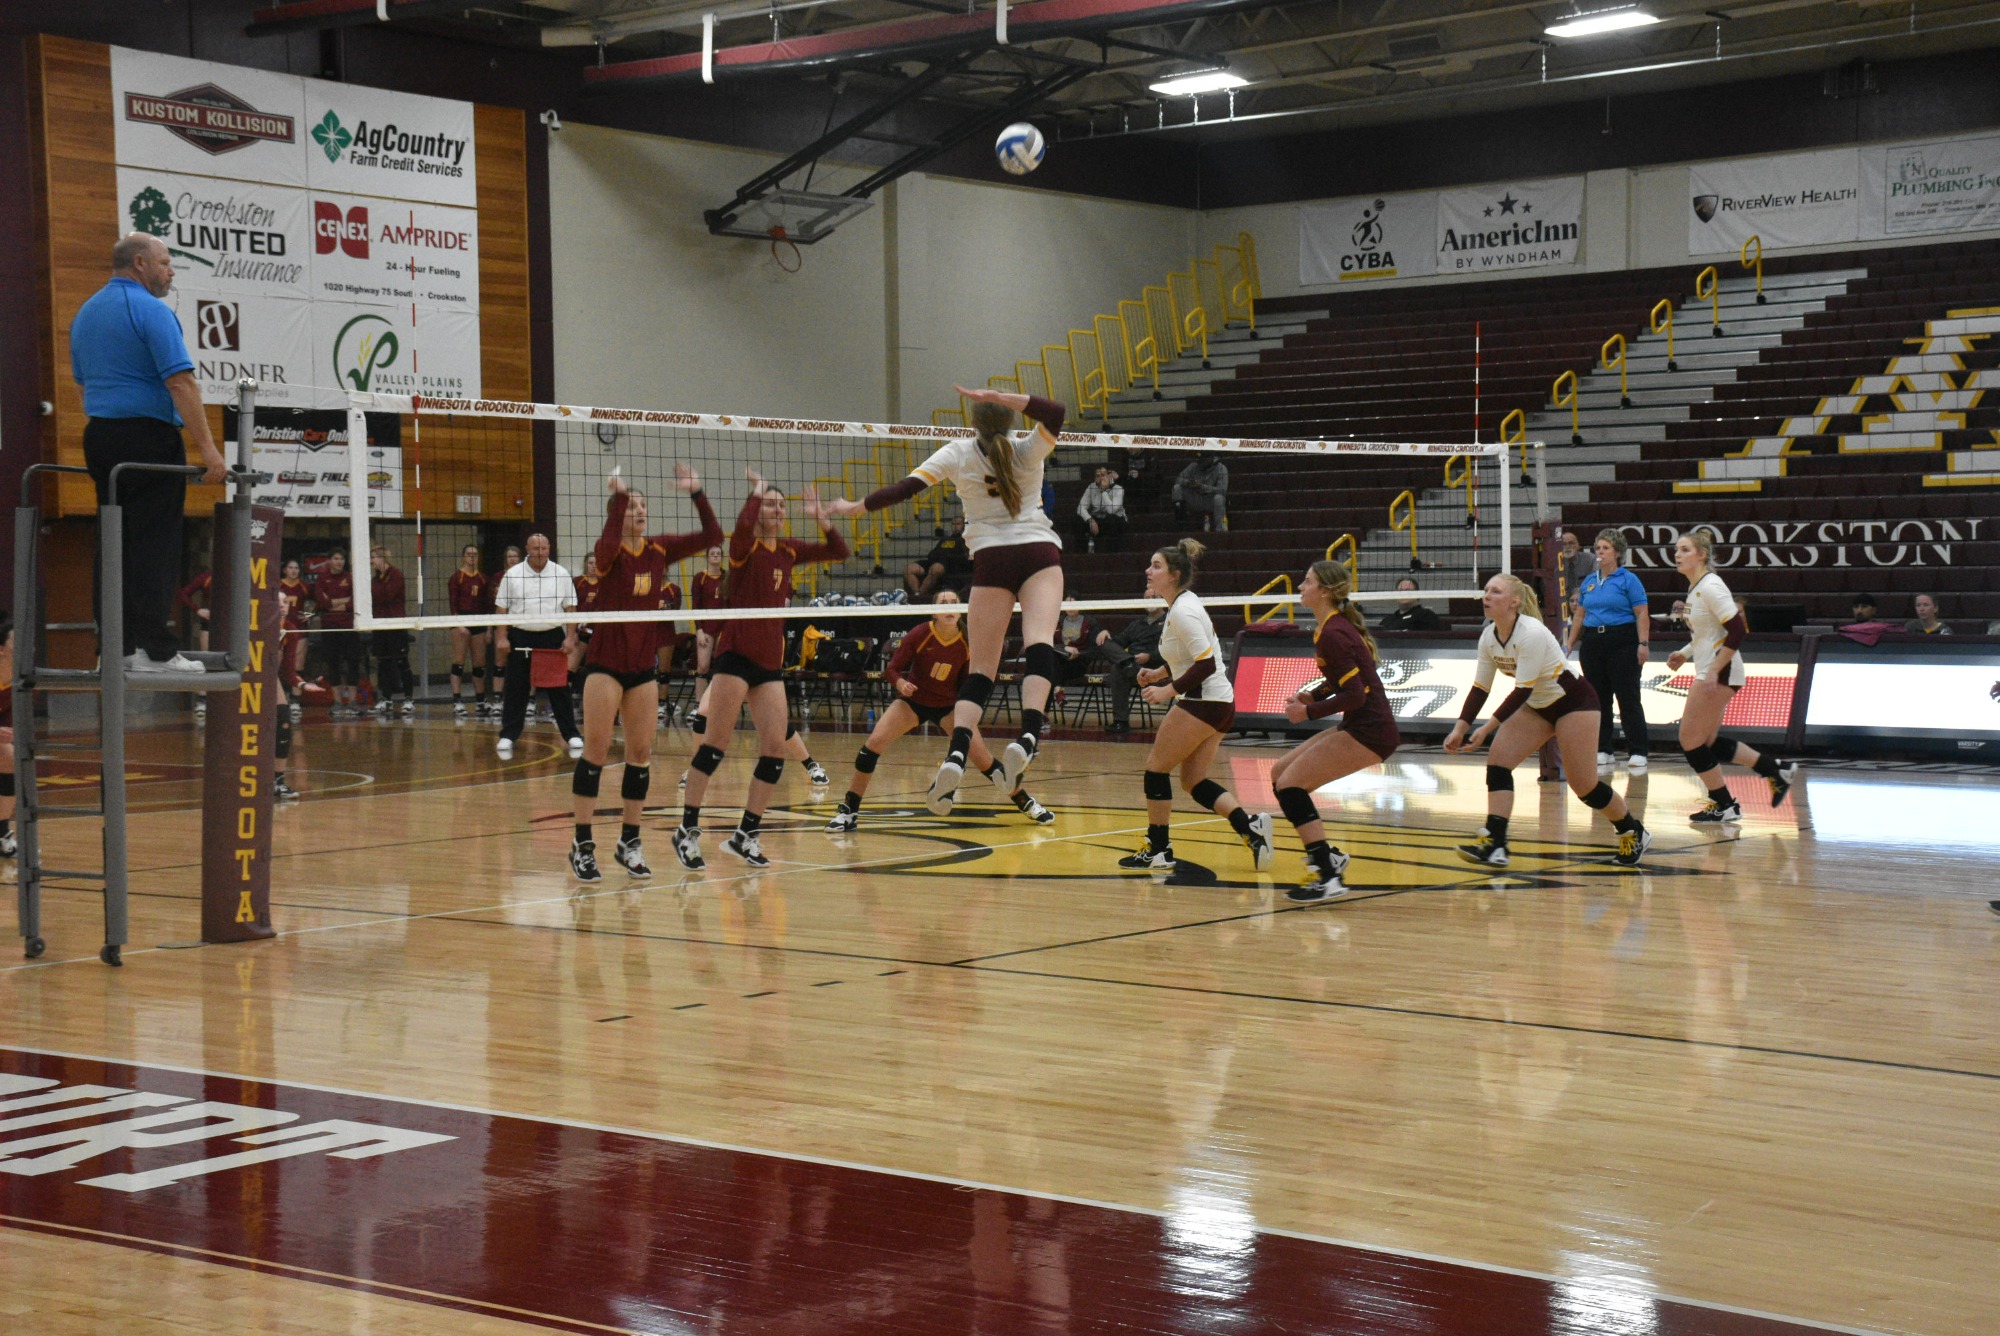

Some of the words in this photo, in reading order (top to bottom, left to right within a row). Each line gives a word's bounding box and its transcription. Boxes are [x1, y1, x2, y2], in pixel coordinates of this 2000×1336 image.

[132, 99, 199, 124] KUSTOM
[207, 107, 288, 136] KOLLISION
[353, 120, 465, 165] AgCountry
[350, 151, 378, 168] Farm
[382, 154, 414, 173] Credit
[417, 158, 463, 178] Services
[176, 191, 275, 228] Crookston
[176, 223, 286, 256] UNITED
[316, 218, 367, 241] CENEX
[380, 224, 469, 250] AMPRIDE
[1440, 220, 1578, 252] AmericInn
[211, 253, 302, 285] Insurance
[1340, 251, 1395, 271] CYBA
[1456, 258, 1474, 269] BY
[1482, 249, 1562, 267] WYNDHAM
[386, 262, 397, 271] 24
[429, 266, 461, 278] Fueling
[324, 282, 343, 292] 1020
[345, 285, 379, 297] Highway
[382, 287, 391, 296] 75
[427, 292, 467, 303] Crookston
[375, 374, 415, 386] VALLEY
[422, 377, 463, 388] PLAINS
[419, 398, 471, 411] INNESOTA
[474, 400, 536, 415] CROOKSTON
[591, 407, 643, 422] MINNESOTA
[645, 410, 700, 425] CROOKSTON
[748, 417, 795, 430] MINNESOTA
[797, 420, 845, 433] CROOKSTON
[321, 472, 349, 482] FINLE
[297, 494, 334, 505] FINLEY
[234, 557, 269, 923] MINNESOTA
